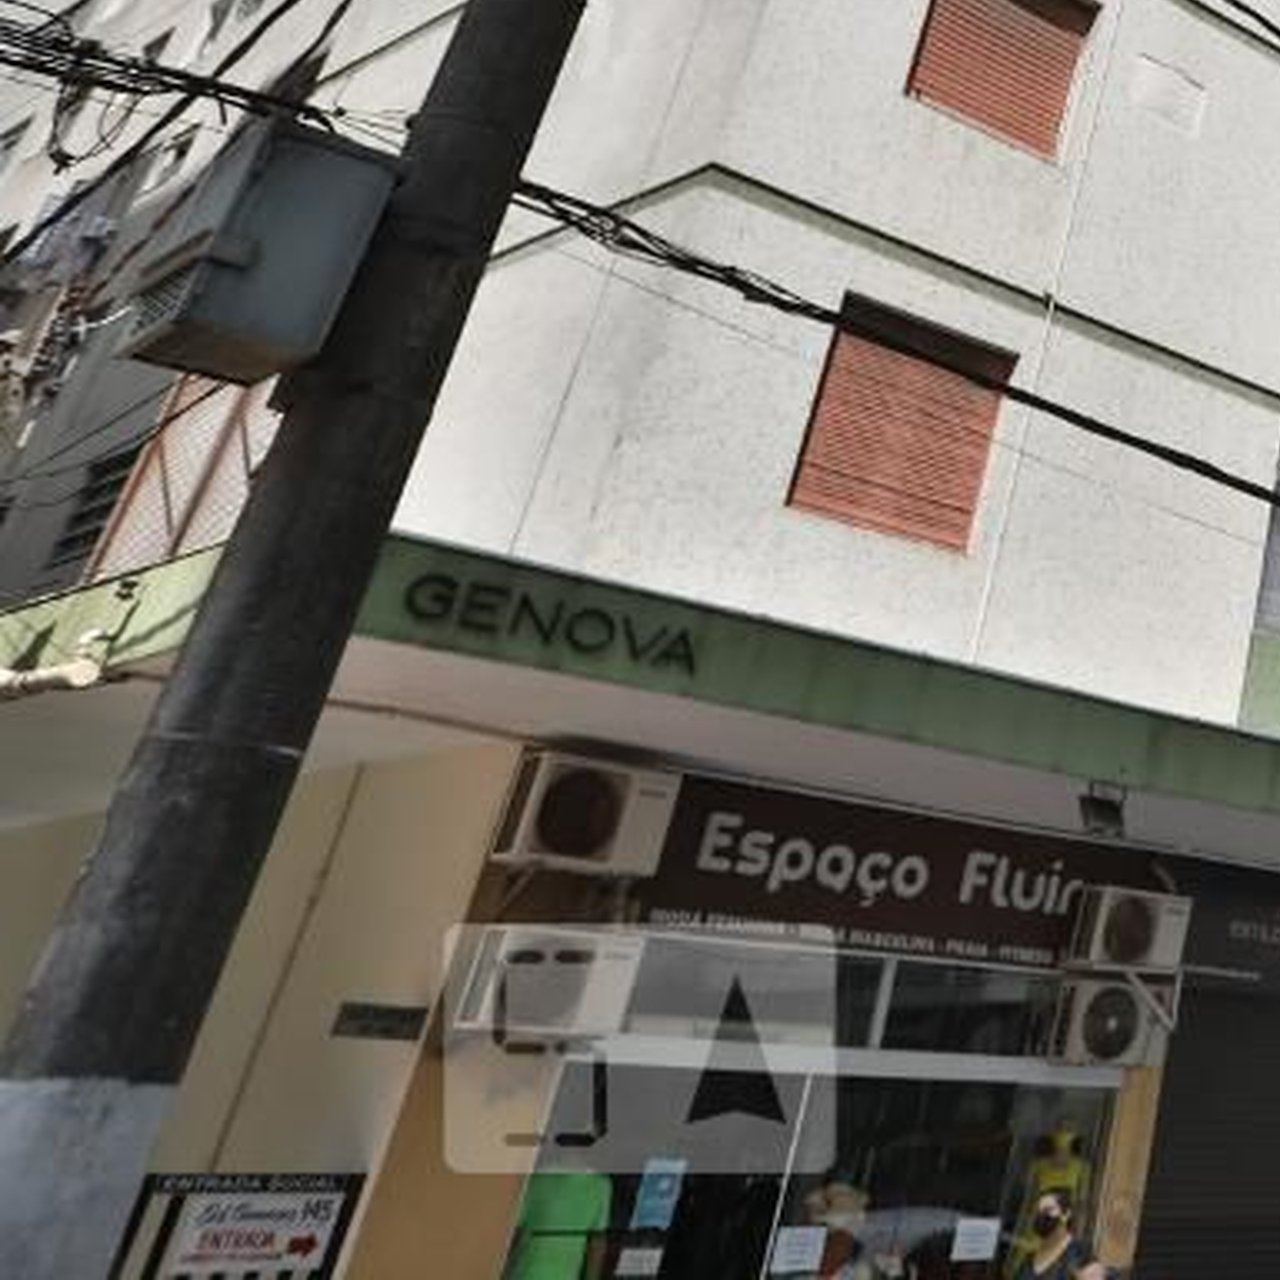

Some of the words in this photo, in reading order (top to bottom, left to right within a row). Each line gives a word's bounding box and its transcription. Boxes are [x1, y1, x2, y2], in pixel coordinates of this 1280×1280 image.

[405, 572, 697, 677] GENOVA
[697, 811, 930, 907] Espaço
[959, 851, 1088, 916] Fluir
